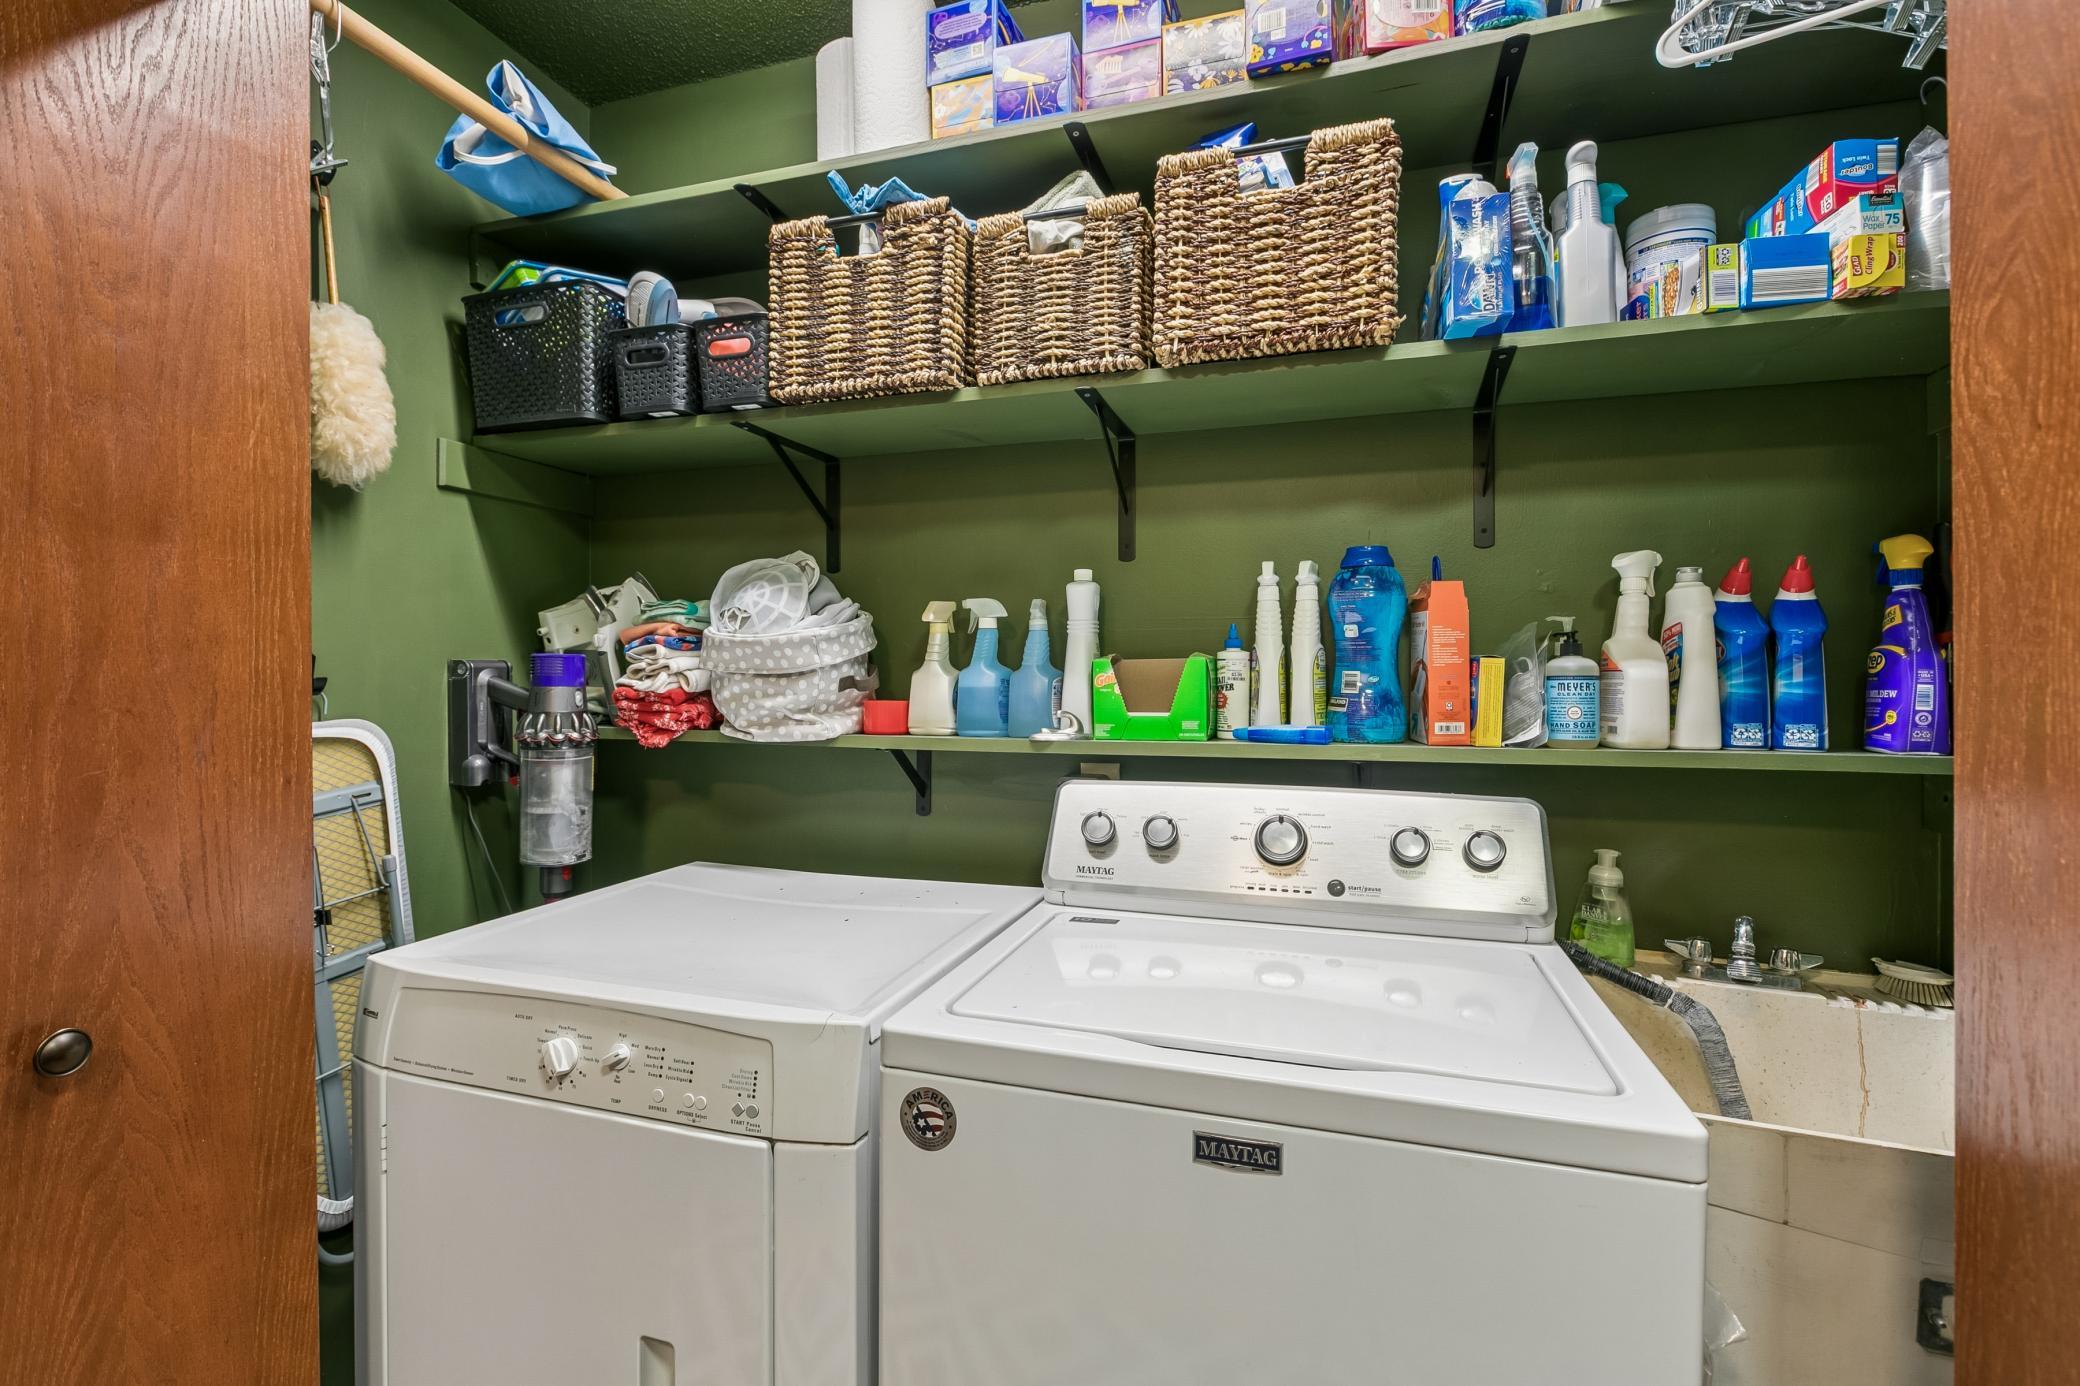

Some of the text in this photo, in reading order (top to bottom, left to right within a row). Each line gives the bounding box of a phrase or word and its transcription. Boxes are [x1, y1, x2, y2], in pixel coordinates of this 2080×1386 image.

[1841, 163, 1874, 176] Boulder
[1863, 214, 1880, 222] Wax
[1885, 212, 1900, 225] 75
[1863, 222, 1886, 231] Paper
[1853, 256, 1862, 275] GLAD
[1482, 273, 1496, 312] DAWN
[1095, 672, 1117, 688] Gai
[1557, 682, 1596, 691] MEYER'S
[1076, 865, 1115, 876] MAYTAG
[1347, 885, 1382, 893] start/pause
[648, 1104, 668, 1113] DRYNESS
[905, 1090, 954, 1120] AMERICA
[676, 1110, 708, 1120] OPTIONS Select
[730, 1118, 745, 1126] START
[745, 1126, 762, 1134] Cancel
[1199, 1140, 1278, 1167] MAYTAG
